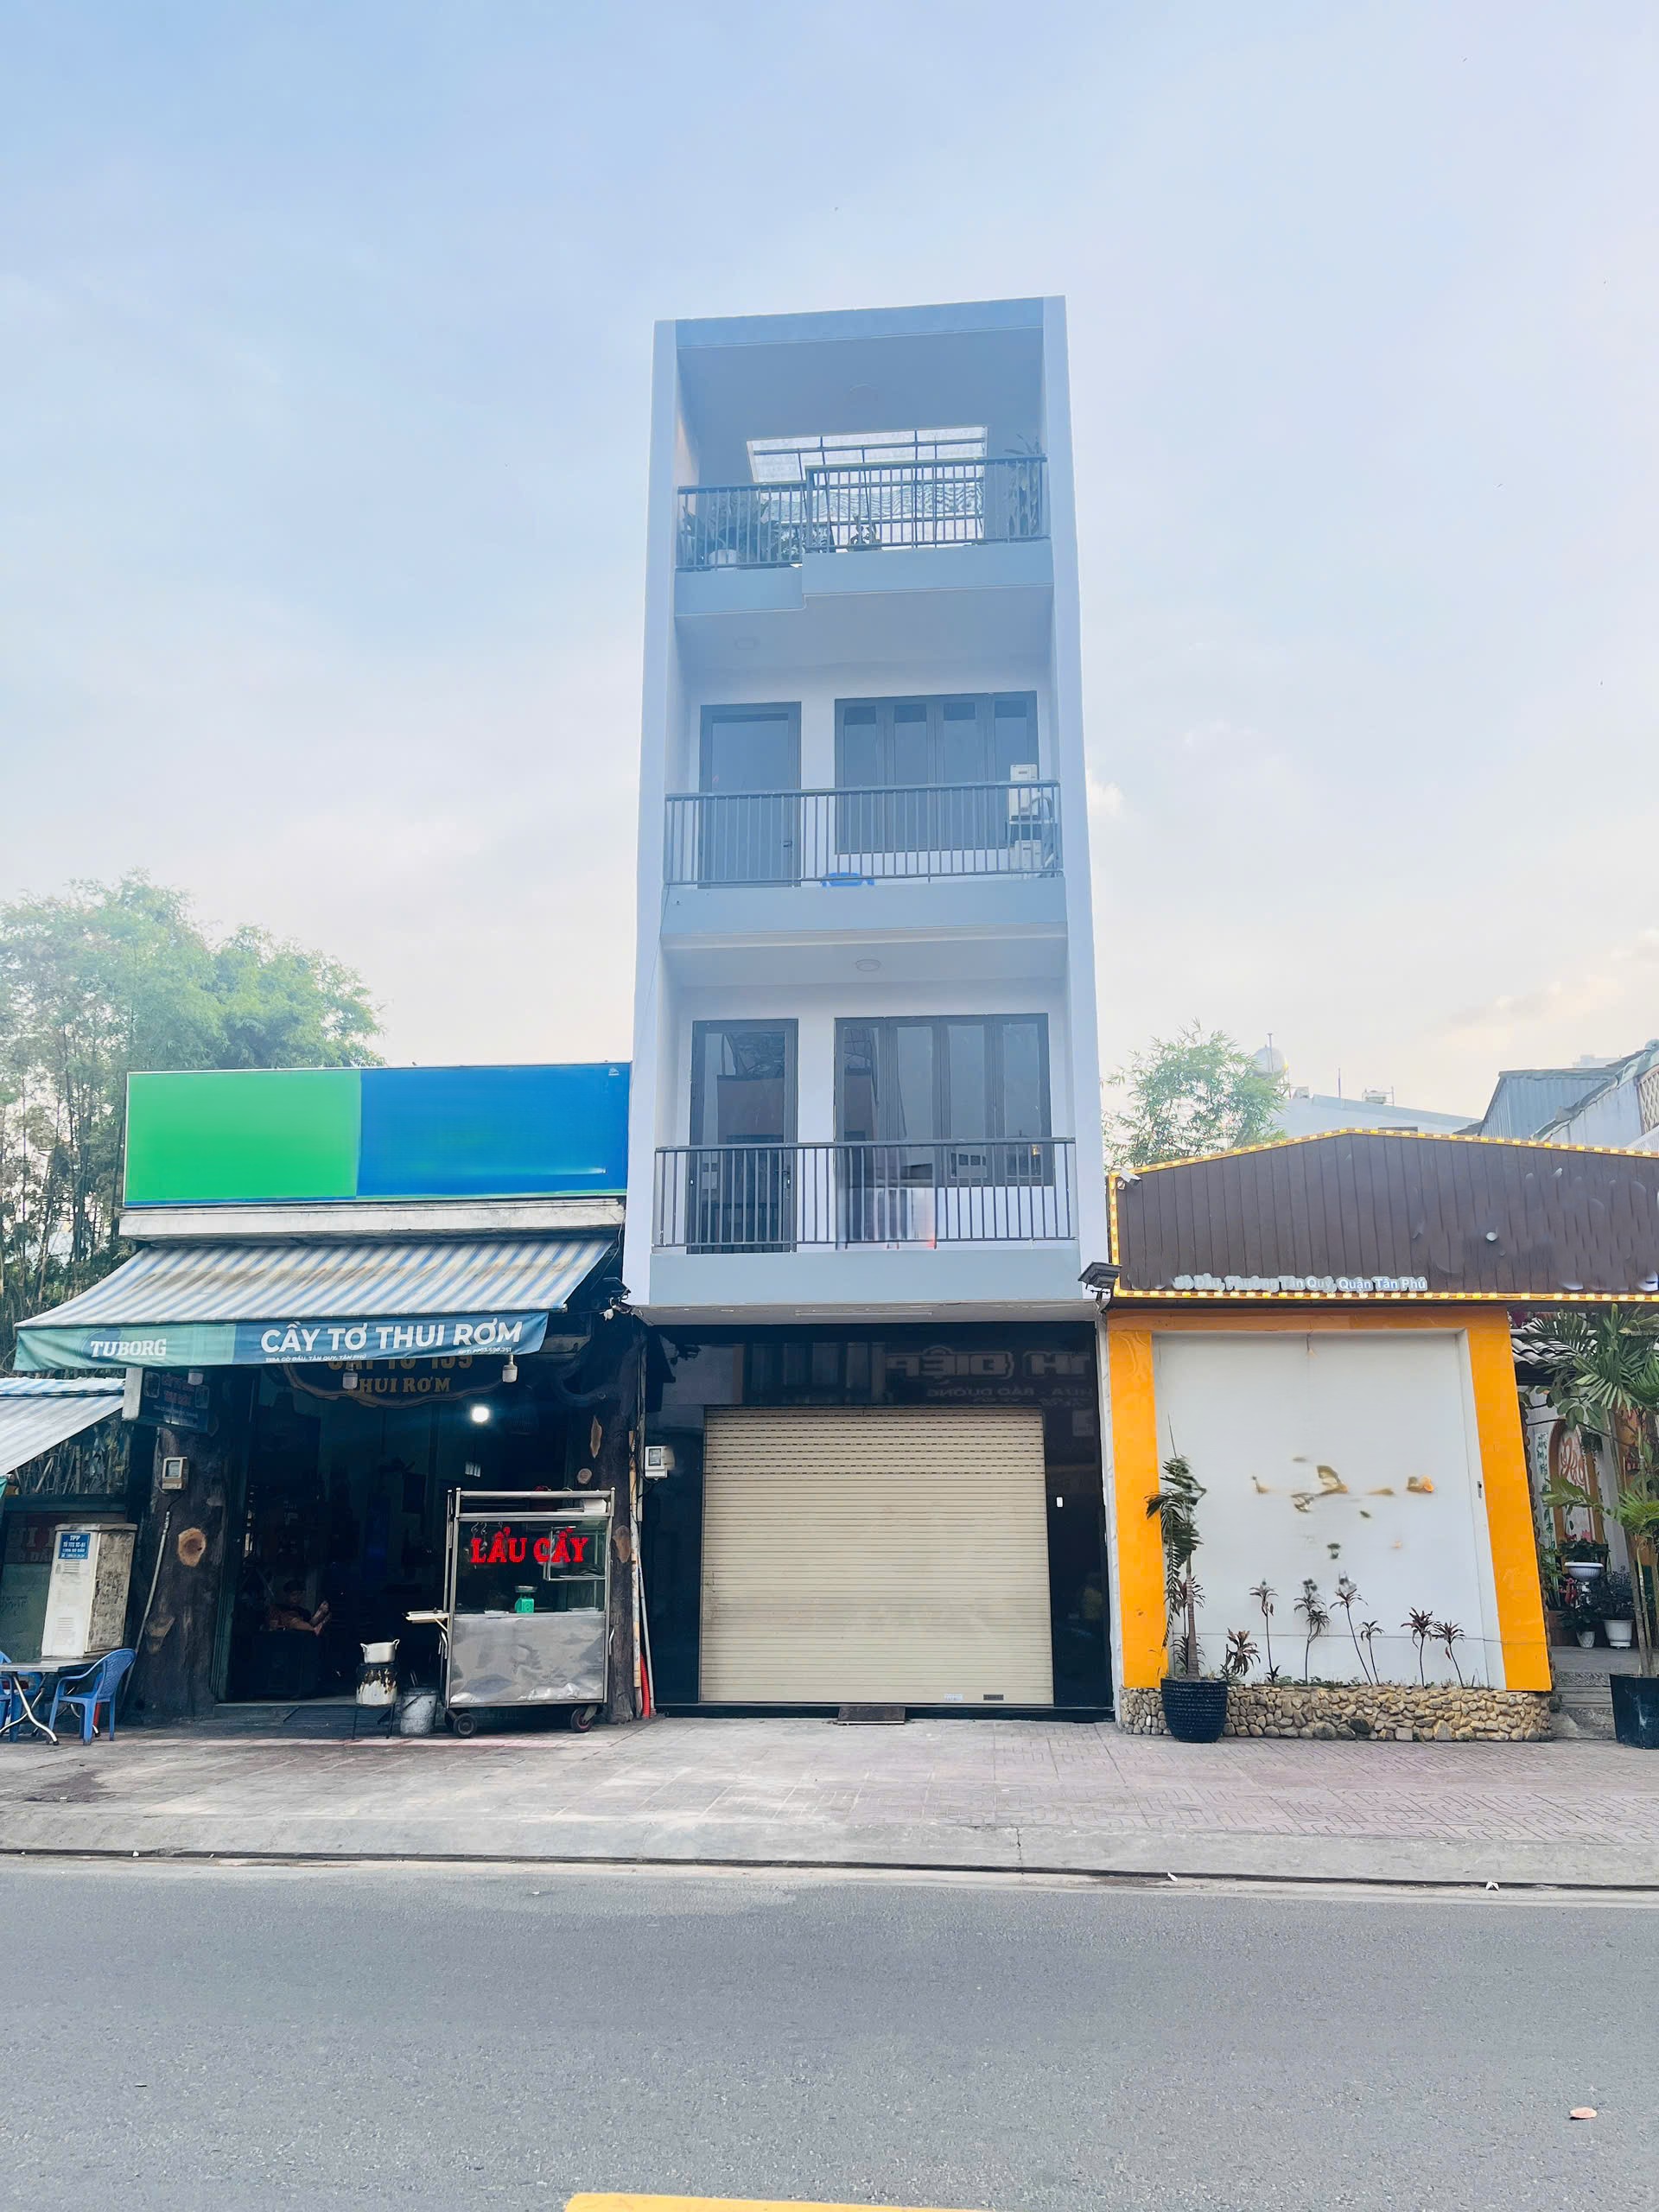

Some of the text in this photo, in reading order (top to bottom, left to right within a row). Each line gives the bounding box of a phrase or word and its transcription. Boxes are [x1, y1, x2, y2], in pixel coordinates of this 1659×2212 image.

[1338, 1278, 1372, 1294] Quận
[1374, 1277, 1398, 1289] Tân
[1401, 1277, 1426, 1290] Phú
[261, 1318, 523, 1353] CẦY TƠ THUI RƠM
[90, 1338, 167, 1358] TUBORG
[355, 1376, 451, 1394] HUI RƠM
[470, 1526, 528, 1564] LẨU
